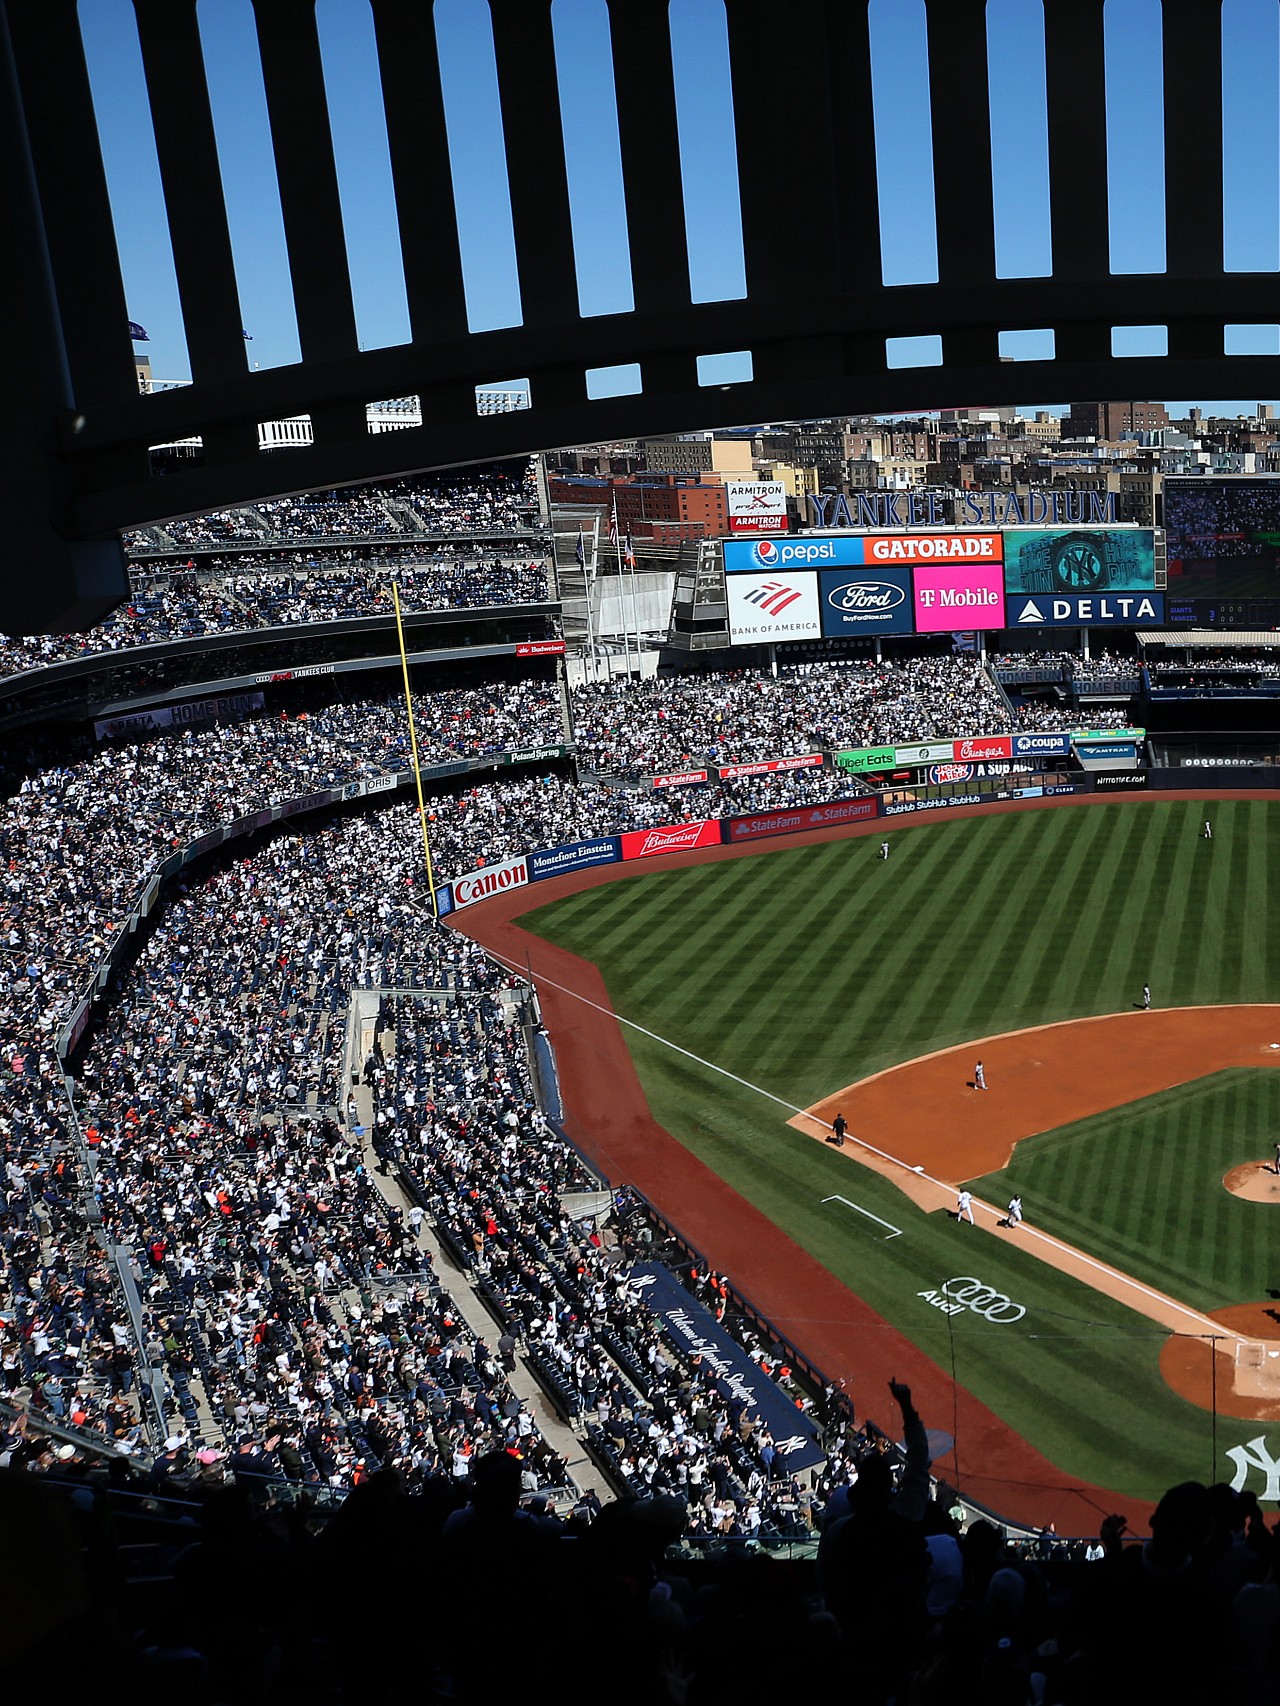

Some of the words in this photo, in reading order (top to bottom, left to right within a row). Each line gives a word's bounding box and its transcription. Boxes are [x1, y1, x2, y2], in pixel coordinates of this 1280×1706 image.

[730, 486, 782, 495] ARMITRON
[807, 493, 946, 528] YANKEE
[965, 490, 1118, 525] STADIUM
[735, 516, 782, 526] ARMITRON
[781, 541, 833, 564] pepsi
[873, 538, 994, 559] GATORADE
[842, 584, 892, 608] Ford
[1053, 598, 1156, 620] DELTA
[1209, 610, 1215, 618] 3
[842, 613, 893, 622] BuyFordNow.com
[731, 626, 758, 635] BANK
[761, 625, 772, 633] OF
[775, 622, 818, 632] AMERICA
[531, 643, 564, 653] Budweiser
[294, 667, 319, 678] YANKEES
[320, 665, 335, 675] CLUB
[999, 671, 1033, 684] HOME
[1035, 670, 1061, 682] RUN
[1074, 681, 1111, 693] HOME
[1114, 680, 1140, 692] RUN
[171, 702, 214, 724] HOME
[218, 696, 251, 715] RUN
[1031, 738, 1064, 749] coupa
[511, 751, 535, 763] Poland
[536, 747, 560, 762] Spring
[867, 755, 893, 765] Eats
[987, 761, 1010, 775] SUB
[367, 777, 392, 789] ORIS
[886, 803, 915, 815] StubHub
[916, 798, 947, 809] StubHub
[949, 795, 980, 806] StubHub
[645, 833, 698, 848] Budweiser
[533, 851, 577, 868] Montefiore
[577, 842, 613, 857] Einstein
[454, 863, 527, 904] Canon
[917, 1289, 966, 1316] Audi
[665, 1307, 698, 1341] Welcome
[688, 1342, 733, 1379] Yankee
[722, 1371, 758, 1407] Stadium
